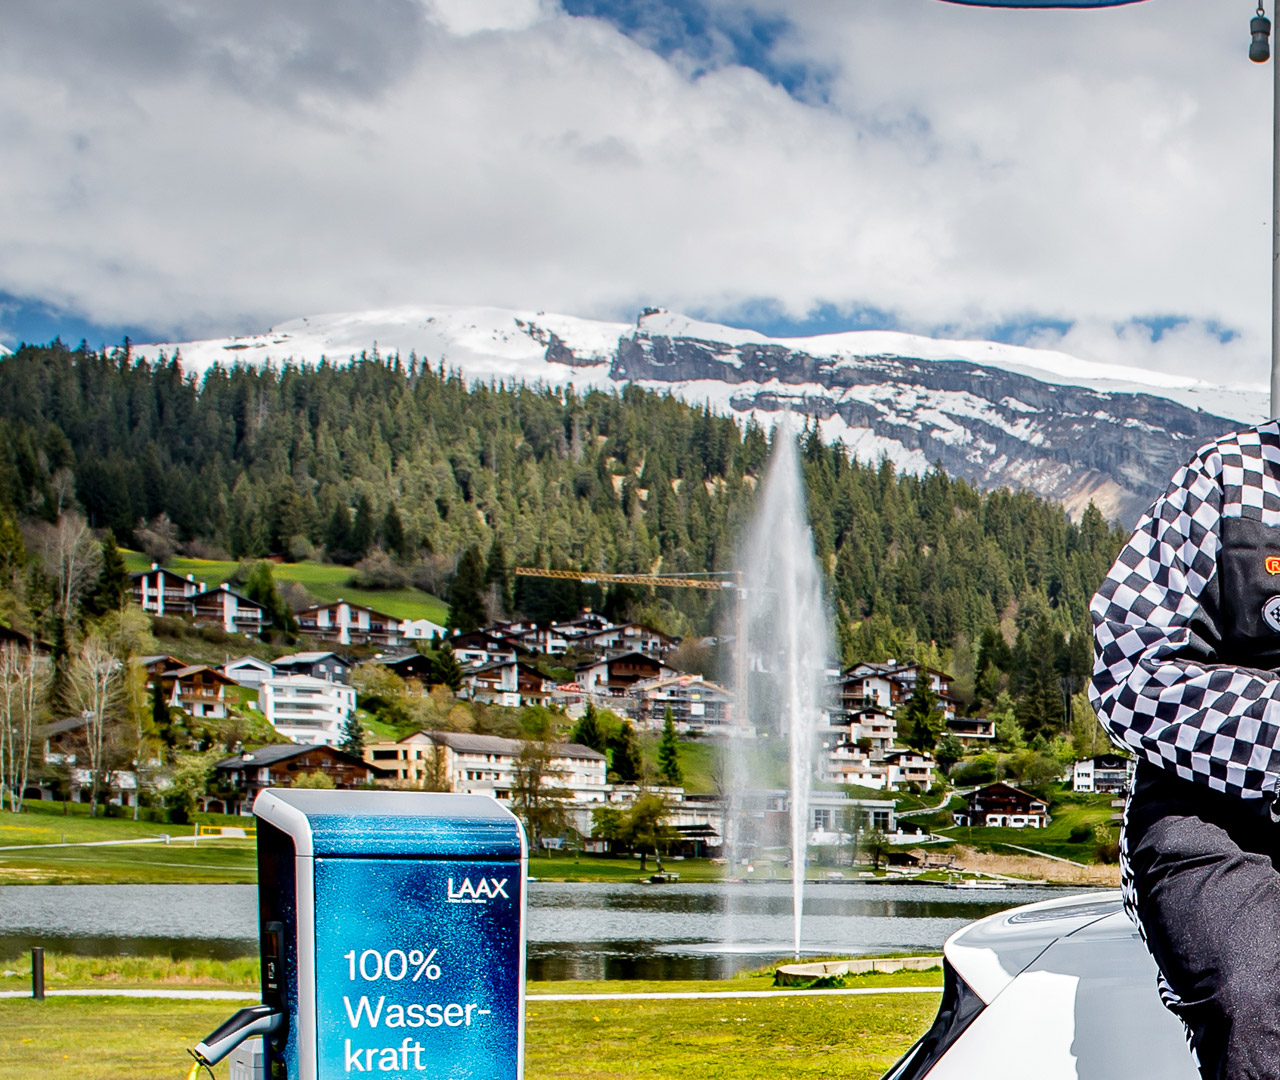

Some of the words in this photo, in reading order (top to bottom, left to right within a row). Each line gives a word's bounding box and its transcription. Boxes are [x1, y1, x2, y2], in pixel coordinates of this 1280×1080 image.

[447, 877, 510, 899] LAAX
[343, 949, 441, 981] 100%
[343, 995, 491, 1029] Wasser-
[344, 1037, 427, 1072] kraft
